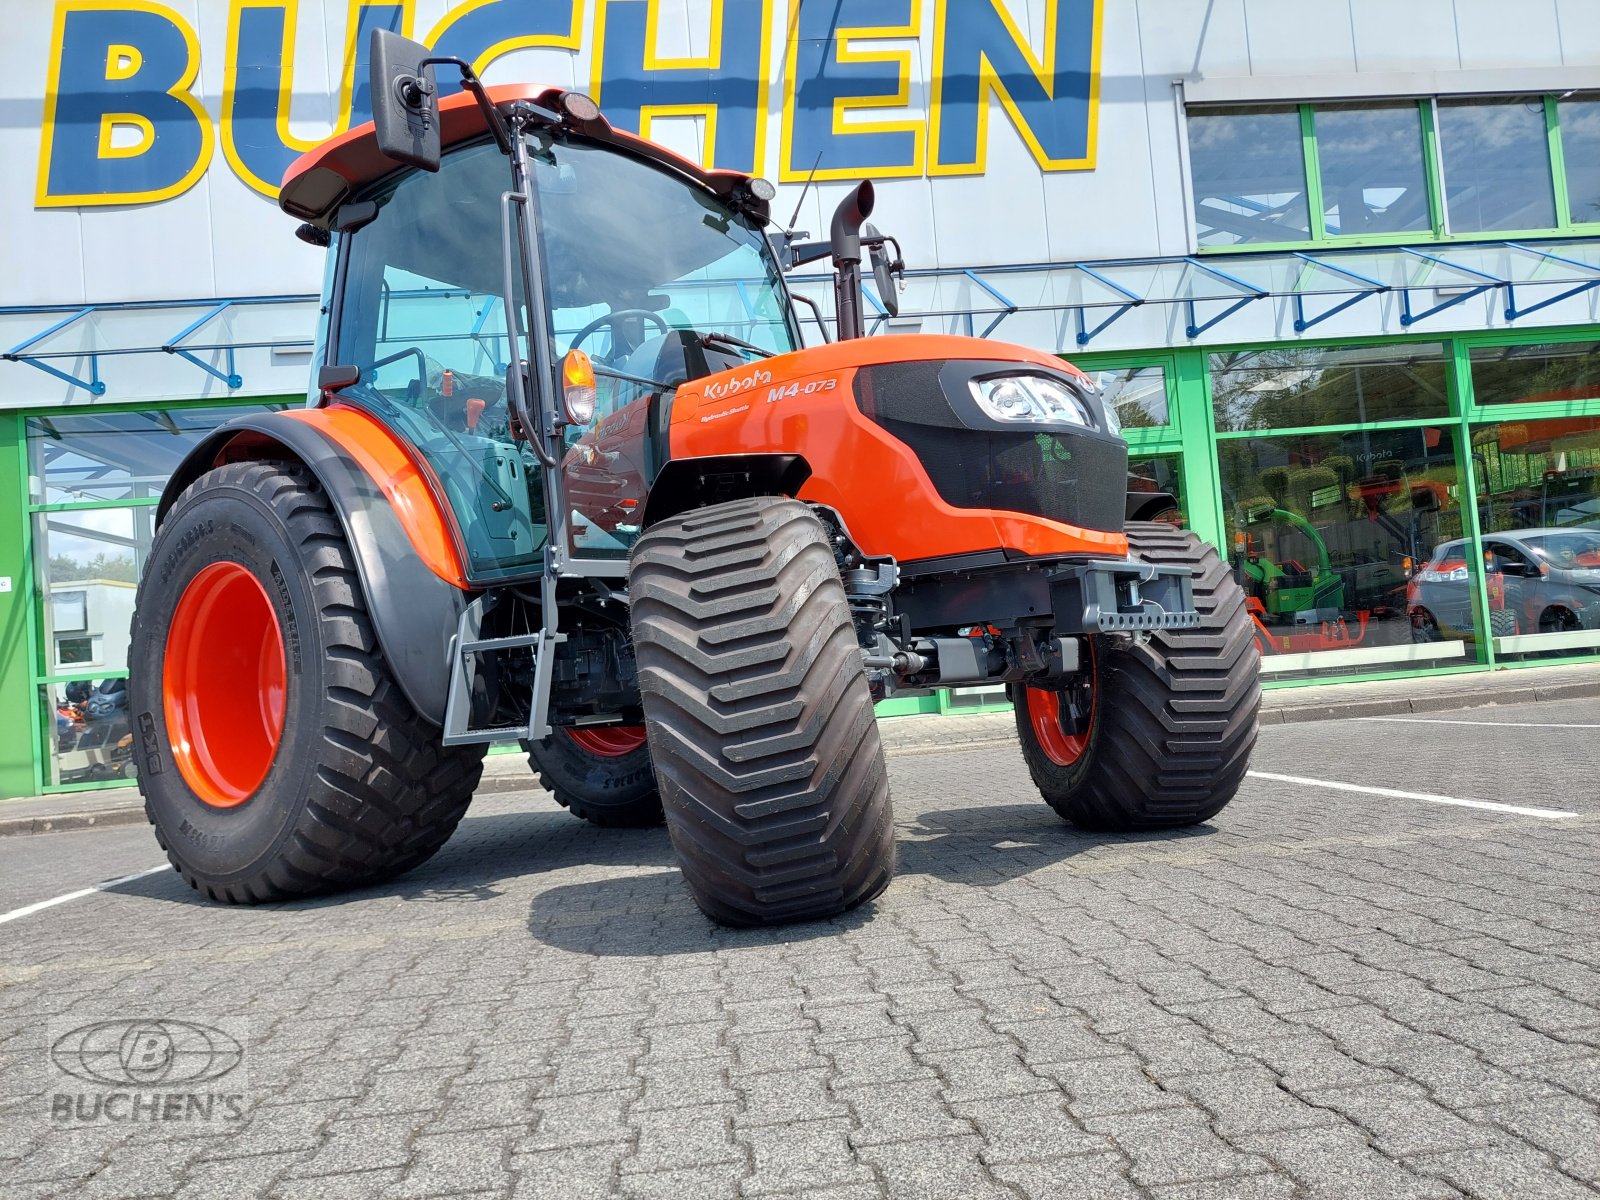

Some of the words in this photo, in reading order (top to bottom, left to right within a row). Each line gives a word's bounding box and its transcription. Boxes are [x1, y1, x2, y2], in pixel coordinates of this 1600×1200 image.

[703, 369, 772, 399] Kubota
[767, 378, 837, 403] M4-073
[1356, 449, 1393, 463] Kubota
[138, 712, 164, 775] BKT
